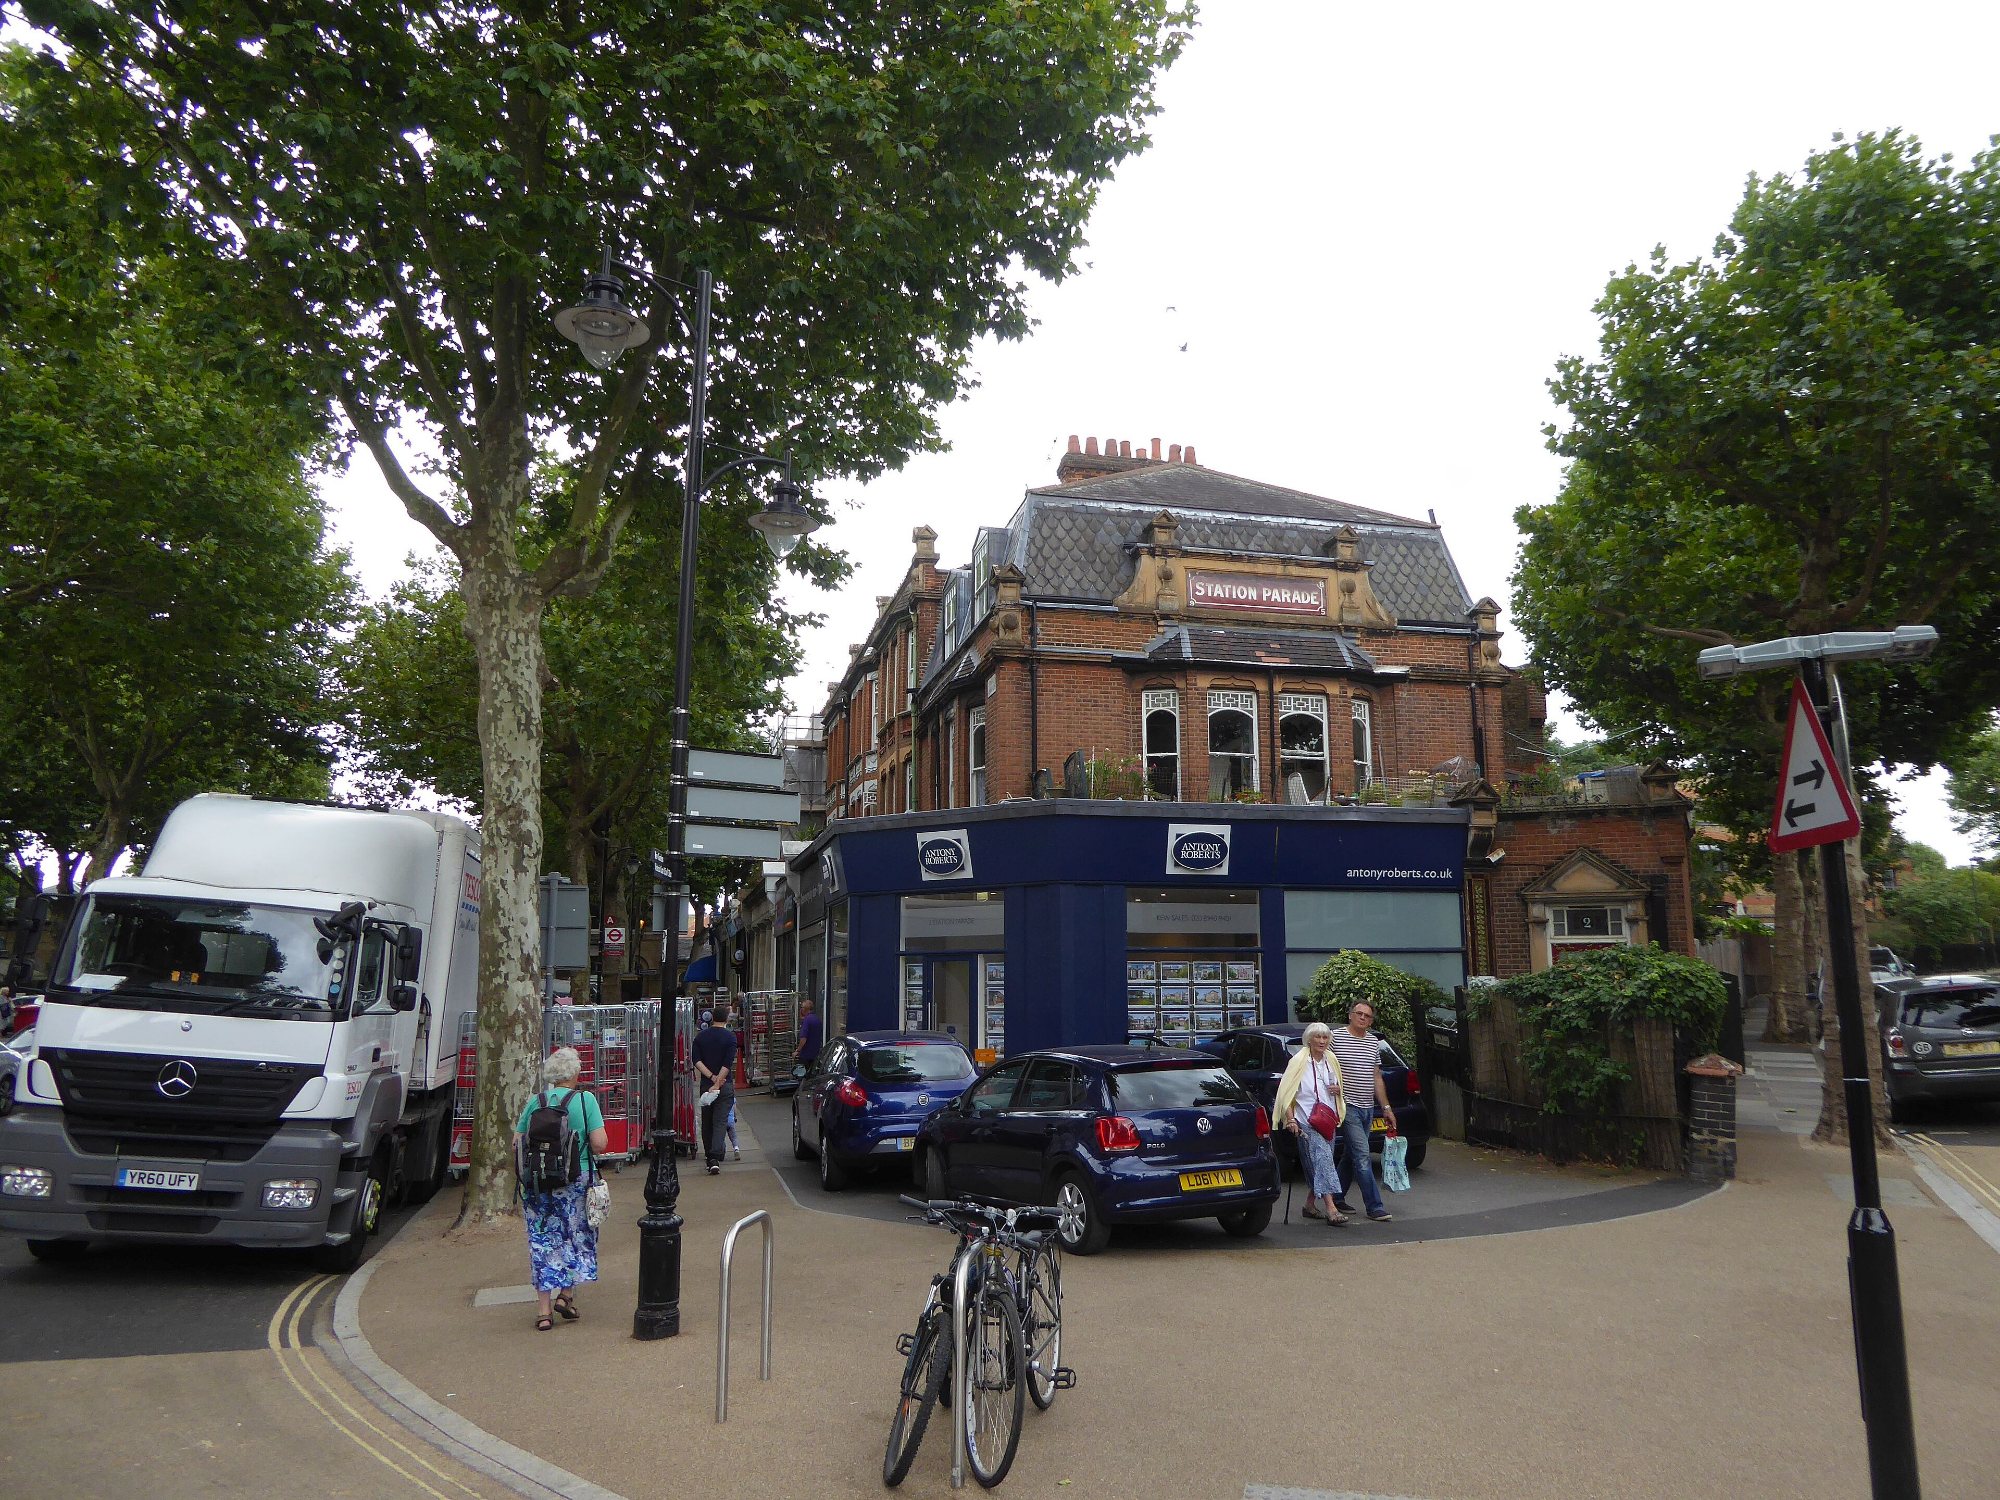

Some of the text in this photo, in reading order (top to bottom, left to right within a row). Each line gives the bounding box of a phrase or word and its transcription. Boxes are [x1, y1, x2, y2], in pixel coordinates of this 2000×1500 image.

[1195, 581, 1320, 605] STATION PARADE
[1181, 842, 1221, 852] ANTONY
[925, 848, 956, 858] ANTONY
[1180, 850, 1221, 859] ROBERTS
[925, 855, 958, 865] ROBERTS
[1346, 867, 1453, 880] antonyroberts.co.uk
[606, 916, 614, 924] A
[1582, 917, 1592, 928] 2
[1915, 1042, 1930, 1052] GB
[129, 1171, 196, 1187] YR60 UFY
[1186, 1171, 1235, 1187] LD61 YVA
